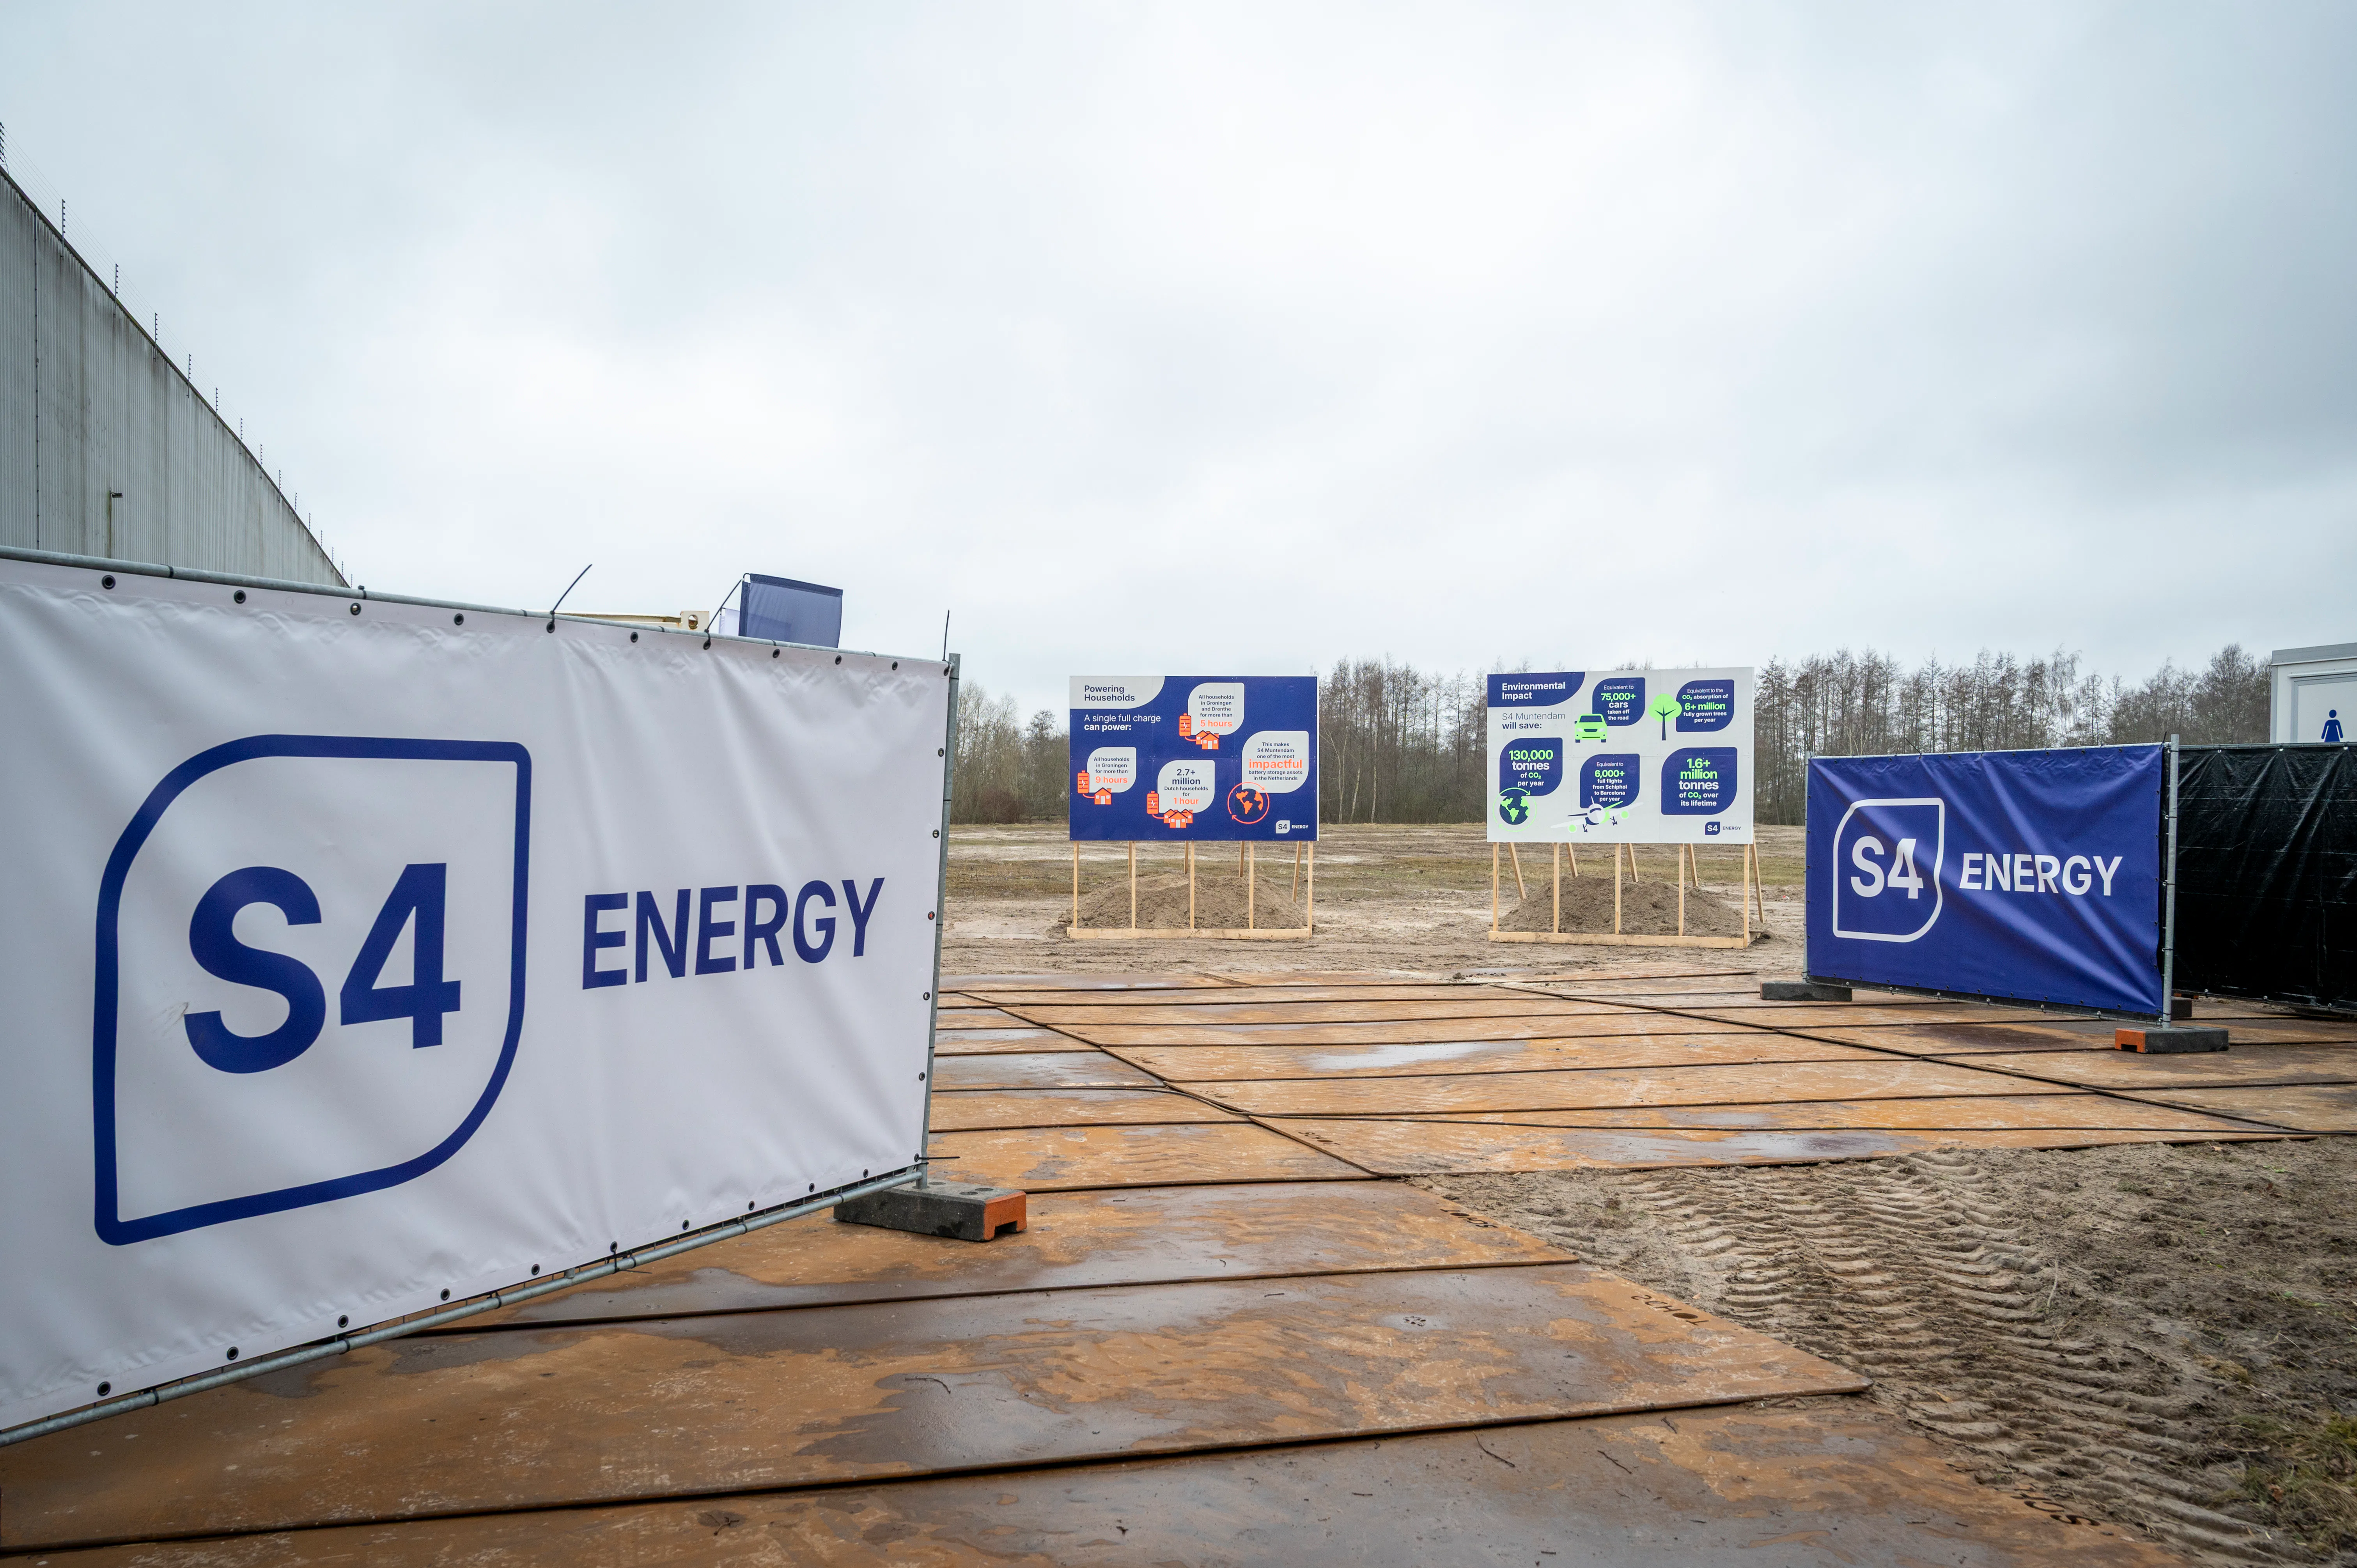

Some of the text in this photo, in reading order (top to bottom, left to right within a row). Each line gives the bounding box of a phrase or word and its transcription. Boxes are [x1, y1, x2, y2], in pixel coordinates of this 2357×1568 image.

[1085, 685, 1124, 694] Powering
[1503, 682, 1565, 690] Environmental
[1503, 692, 1532, 701] Impact
[1601, 693, 1636, 702] 75,000+
[1093, 714, 1116, 723] single
[1133, 714, 1161, 723] charge
[1509, 750, 1553, 762] 130,000
[1249, 759, 1302, 770] impactful
[1512, 762, 1549, 770] tonnes
[1687, 758, 1710, 768] 1.6+
[1595, 770, 1625, 778] 6,000+
[1680, 769, 1717, 779] million
[1679, 781, 1719, 790] tonnes
[1851, 836, 1923, 898] S4
[1959, 853, 2122, 896] ENERGY
[583, 877, 884, 990] ENERGY
[184, 863, 461, 1074] S4
